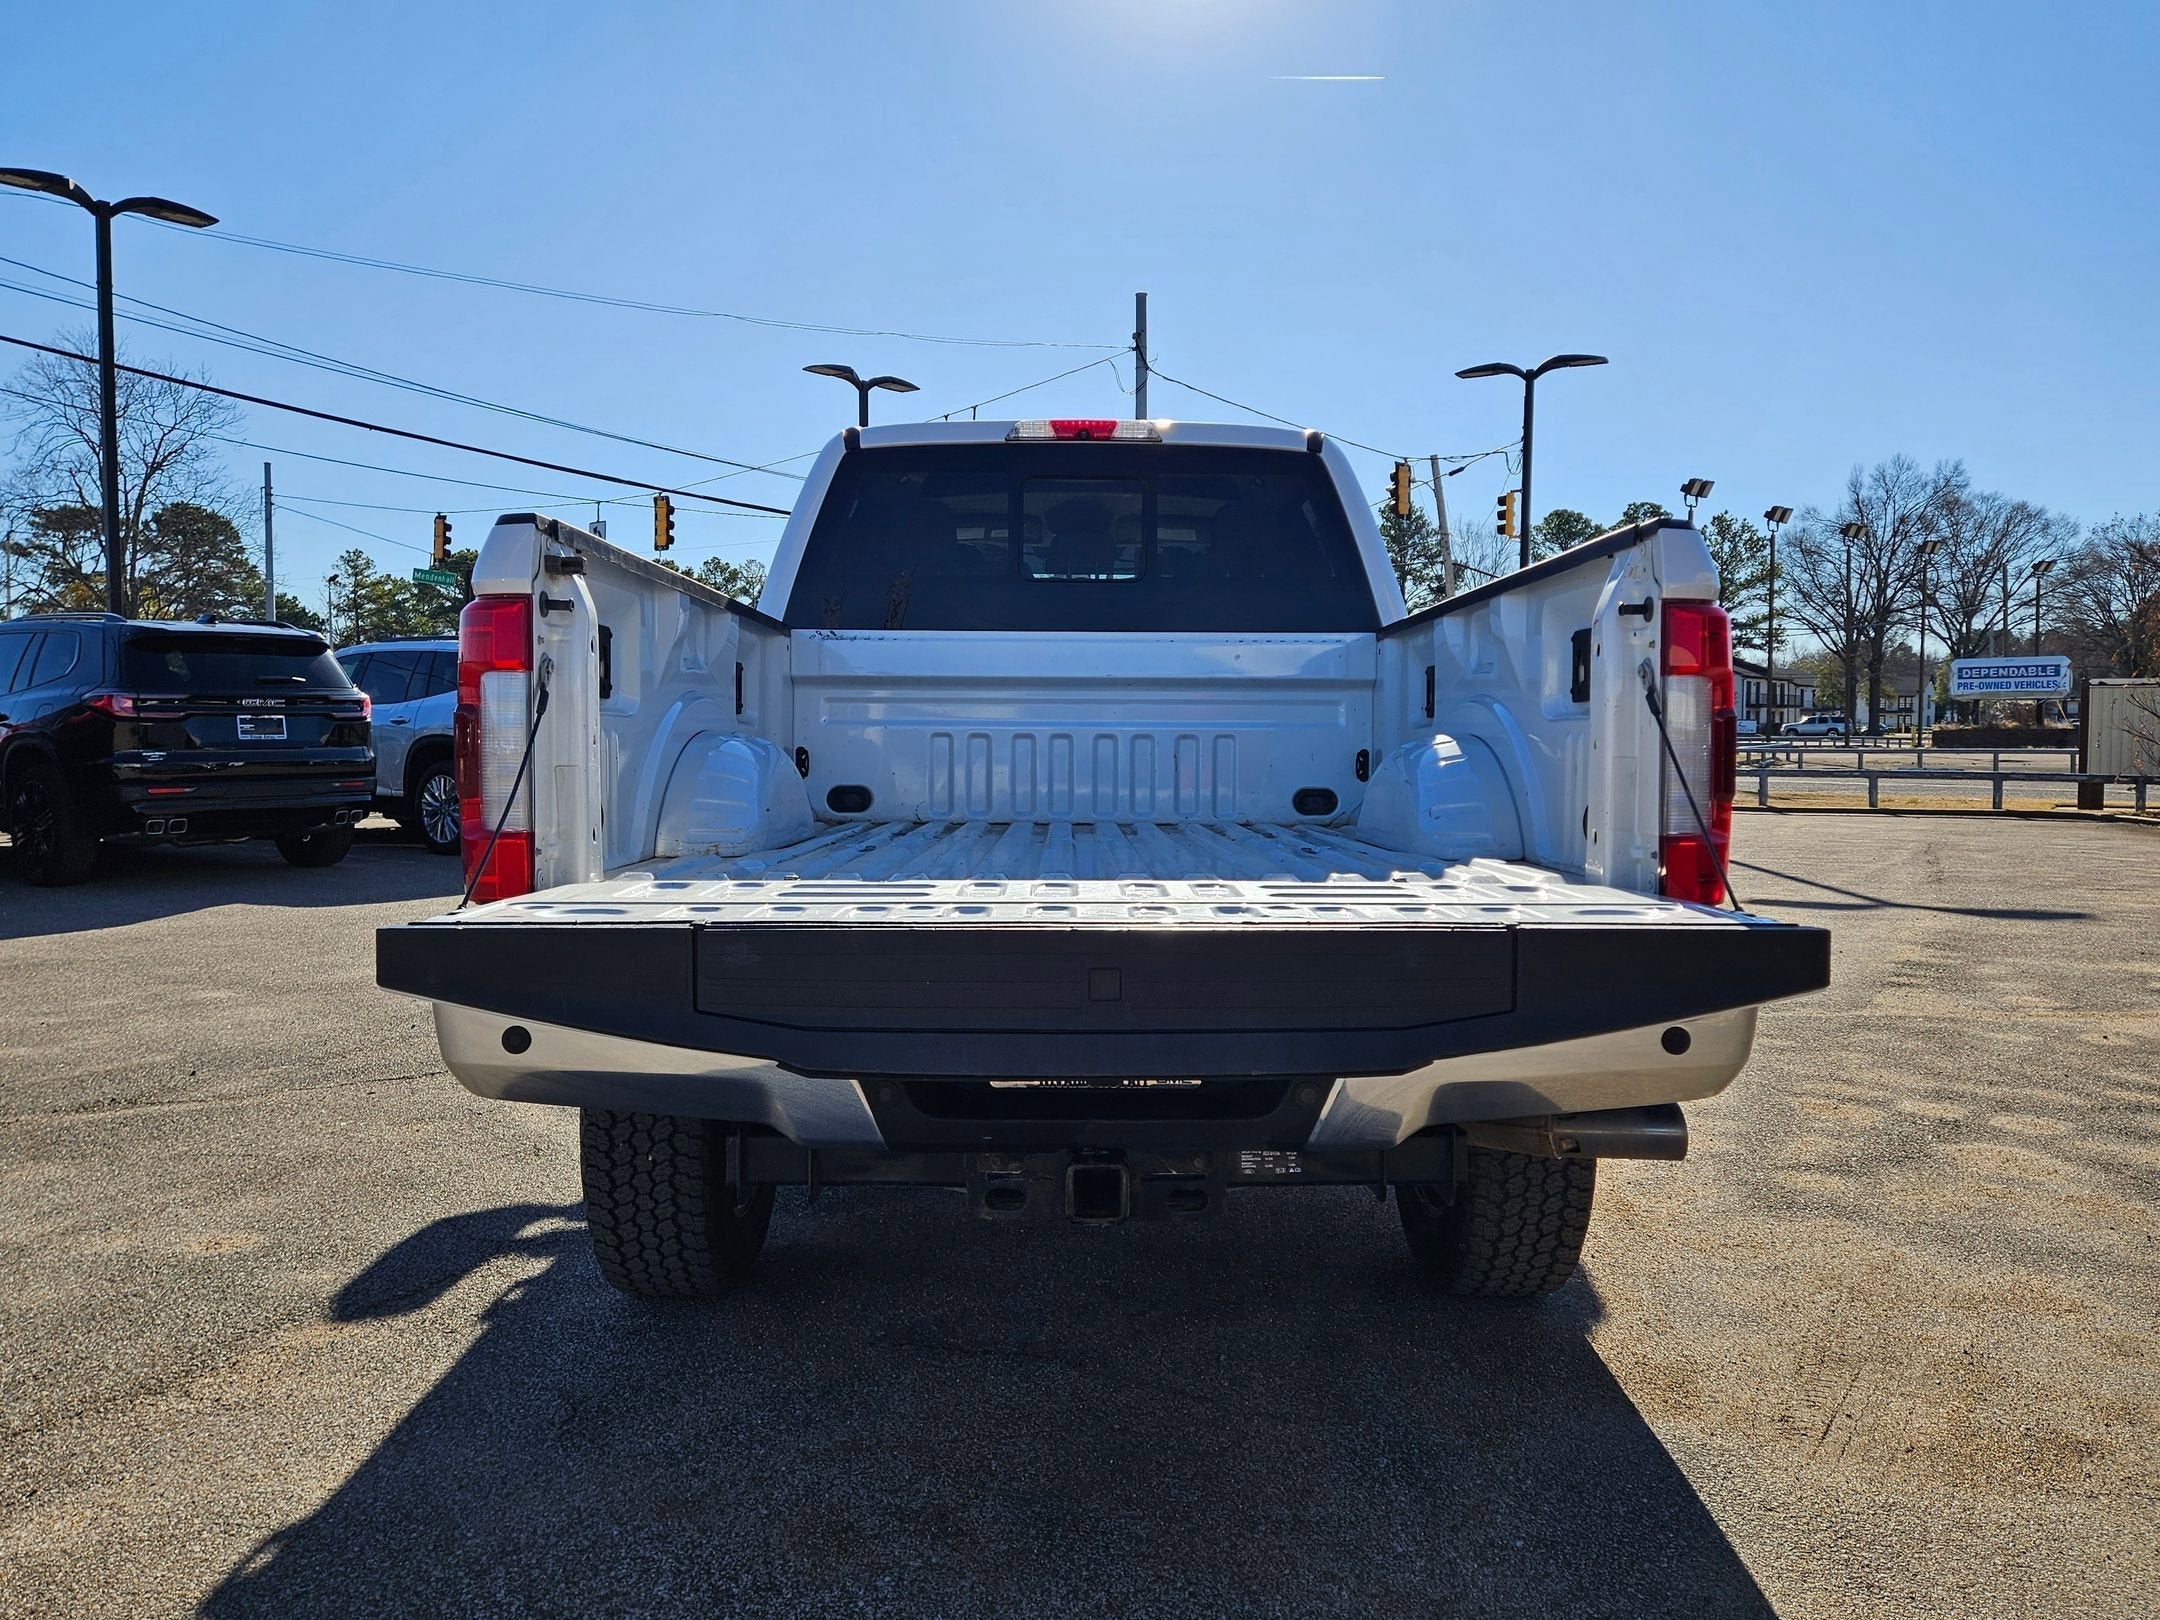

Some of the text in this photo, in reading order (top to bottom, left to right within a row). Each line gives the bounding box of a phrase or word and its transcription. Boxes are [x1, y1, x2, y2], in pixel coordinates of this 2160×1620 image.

[414, 571, 455, 584] Mendenhall
[1962, 666, 2056, 678] DEPENDABLE
[1957, 680, 2059, 690] PRE-OWNED VEHICLES
[242, 698, 286, 708] GMC
